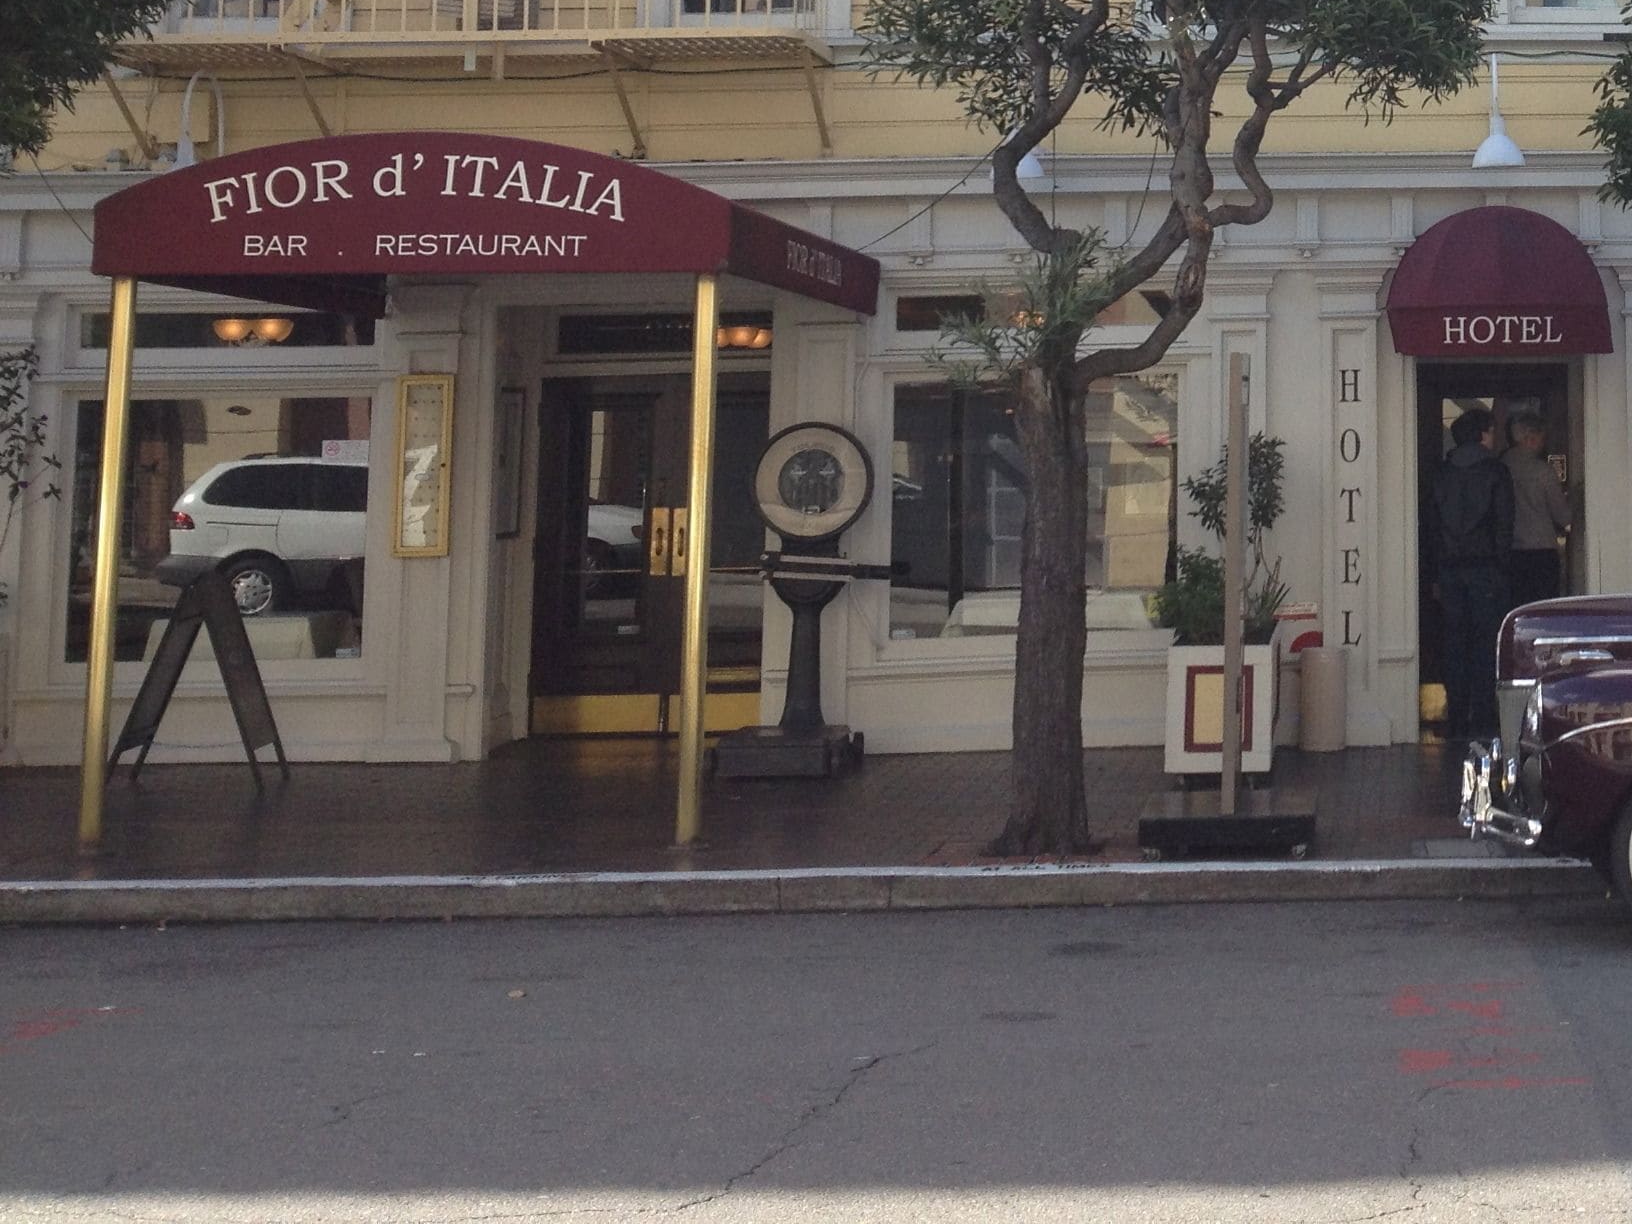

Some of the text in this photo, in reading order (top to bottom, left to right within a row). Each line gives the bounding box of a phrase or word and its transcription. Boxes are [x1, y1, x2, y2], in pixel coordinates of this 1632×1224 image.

[203, 159, 353, 223] FIOR
[243, 233, 588, 257] BAR RESTAURANT
[1442, 315, 1563, 344] HOTEL
[1338, 368, 1363, 647] HOTEL
